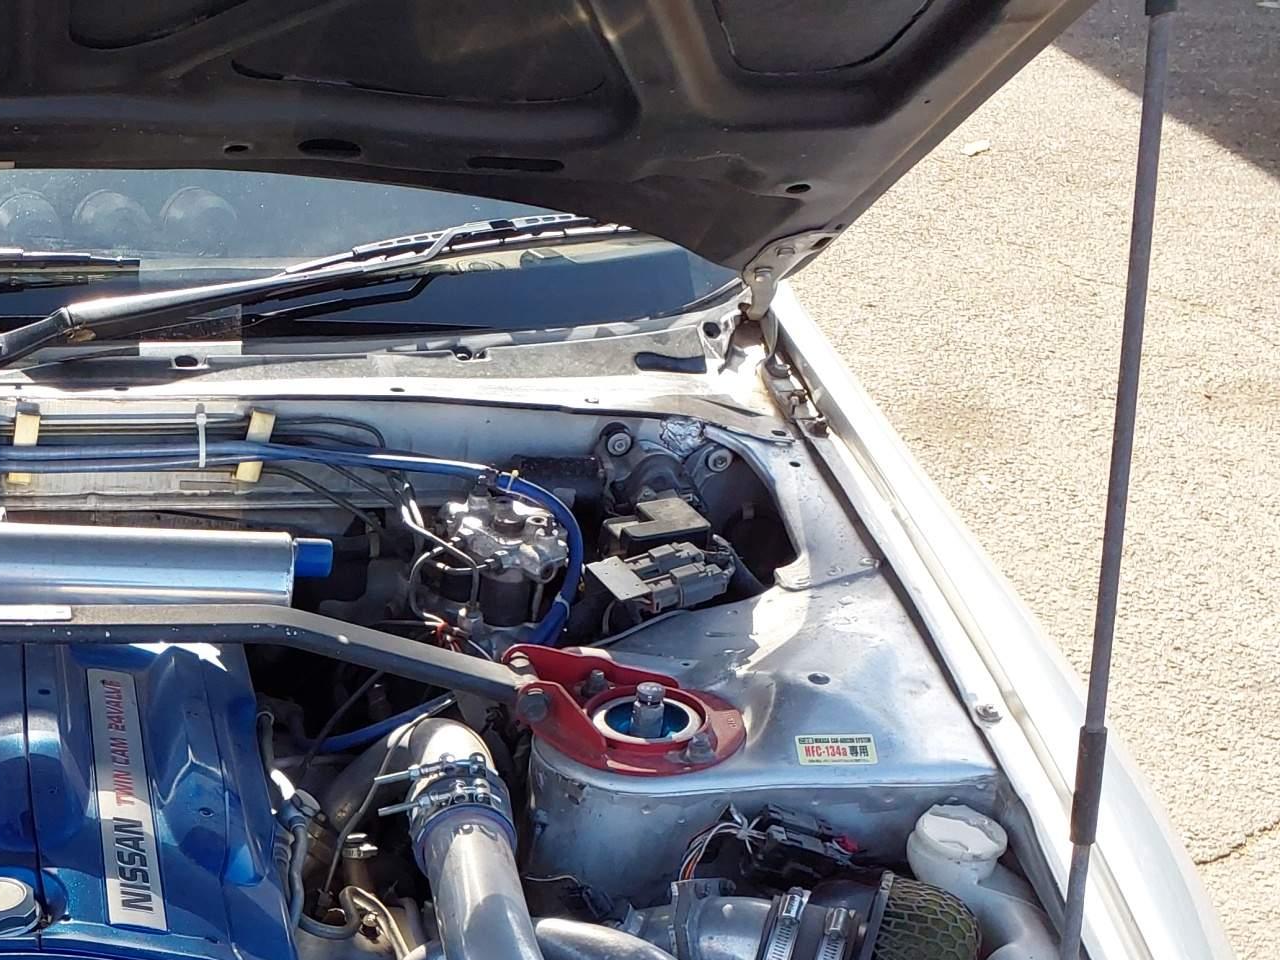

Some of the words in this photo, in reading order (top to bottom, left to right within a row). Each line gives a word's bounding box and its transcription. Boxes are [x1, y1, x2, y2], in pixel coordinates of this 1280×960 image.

[109, 737, 130, 766] CAM
[804, 745, 848, 757] HFC-134a
[112, 769, 135, 807] TWIN
[112, 816, 154, 912] NISSAN
